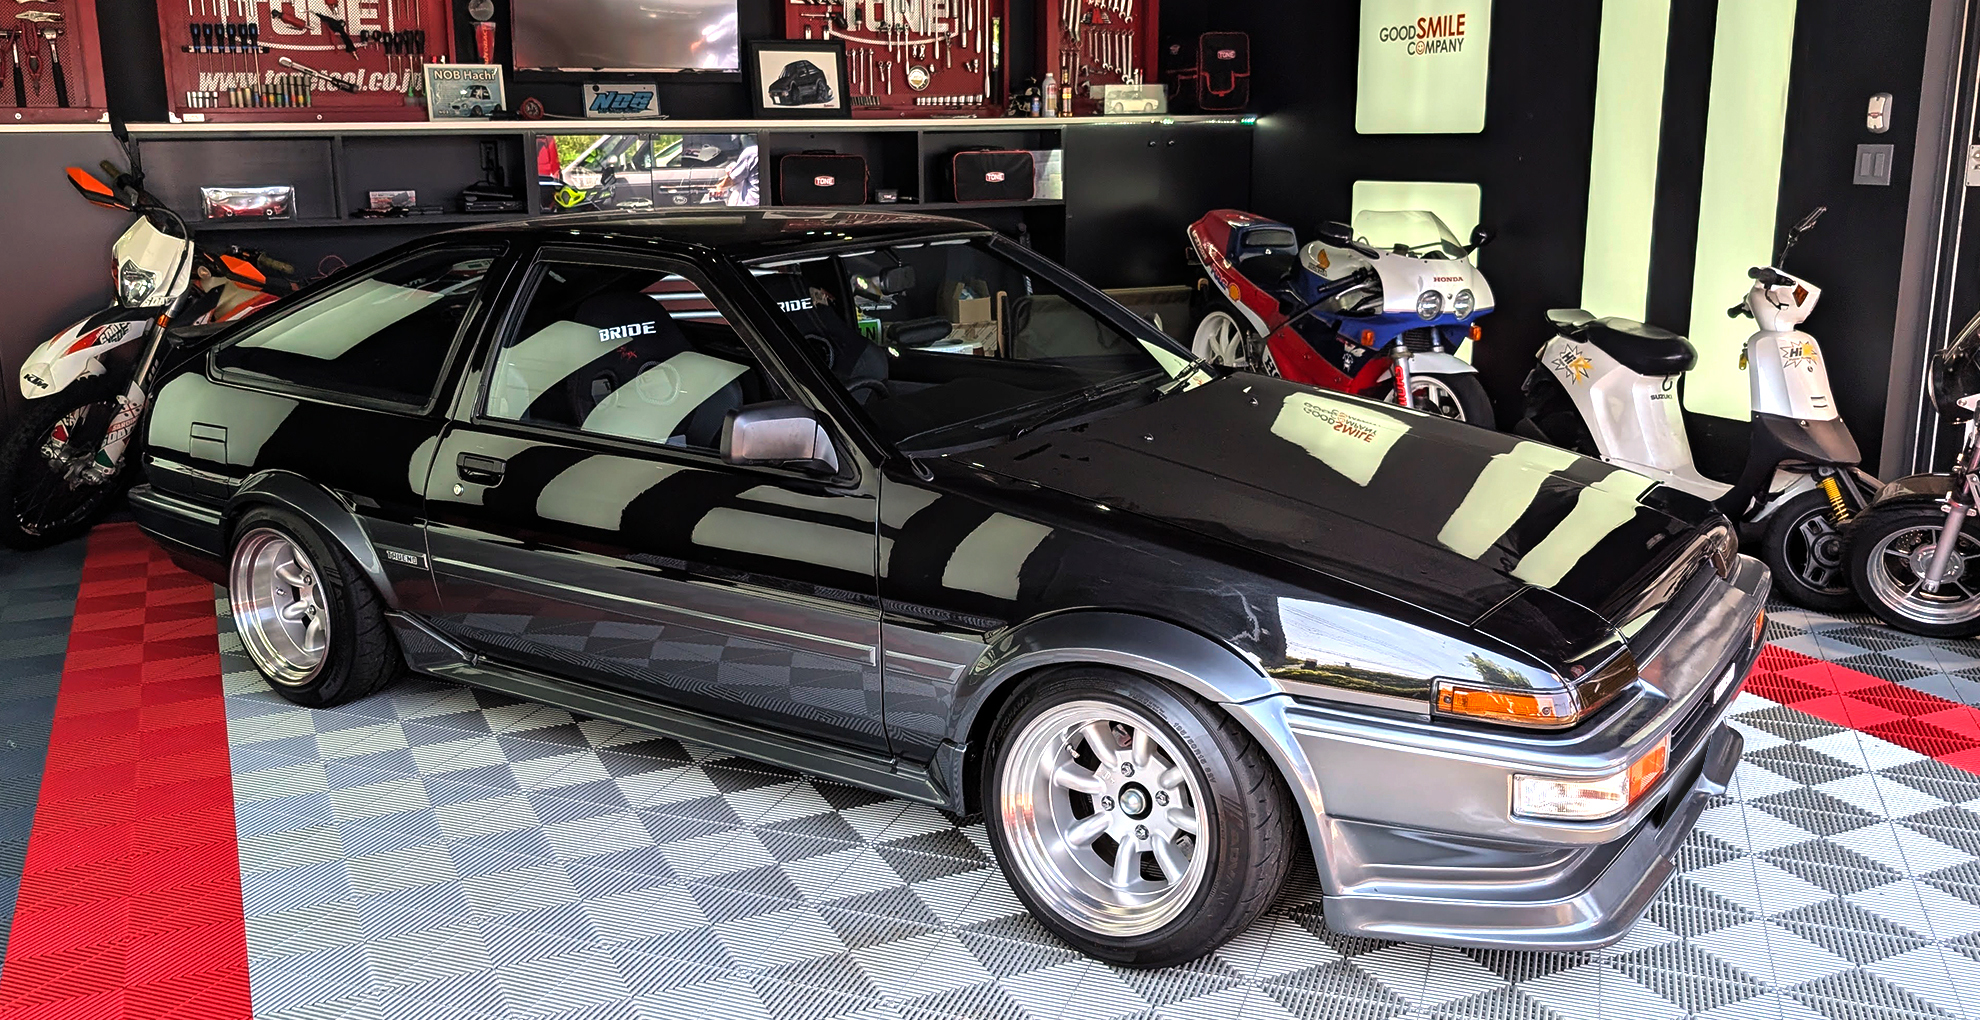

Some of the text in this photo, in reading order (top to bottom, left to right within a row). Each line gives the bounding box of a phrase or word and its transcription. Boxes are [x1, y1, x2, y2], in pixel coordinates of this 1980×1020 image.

[1379, 13, 1466, 42] GOOD SMILE
[433, 69, 461, 81] NOB
[814, 176, 835, 186] TONE
[985, 173, 1004, 182] TONE
[776, 297, 813, 313] RIDE
[598, 320, 657, 343] BRIDE
[1562, 351, 1577, 365] Hi
[1790, 347, 1803, 358] Hi
